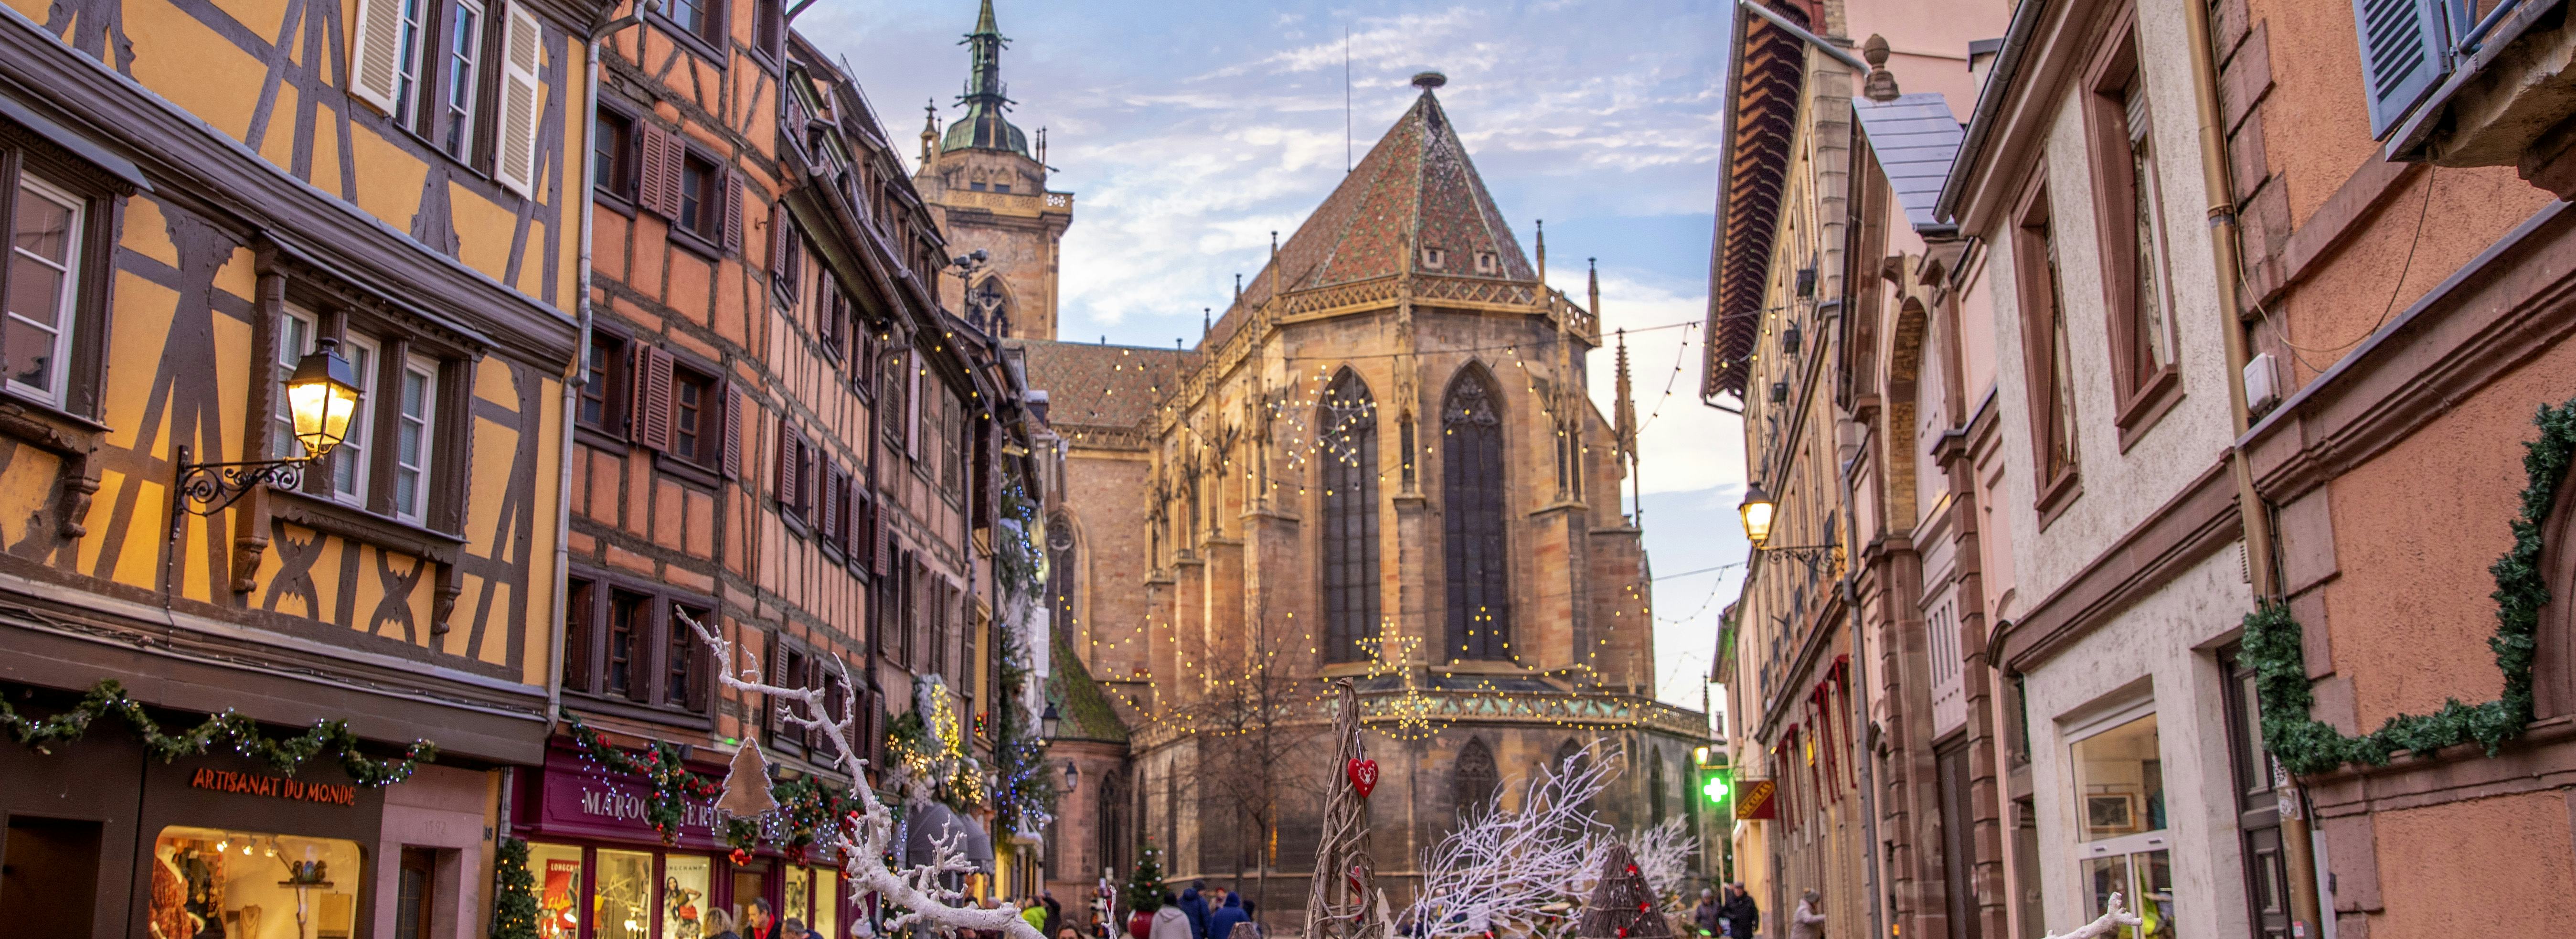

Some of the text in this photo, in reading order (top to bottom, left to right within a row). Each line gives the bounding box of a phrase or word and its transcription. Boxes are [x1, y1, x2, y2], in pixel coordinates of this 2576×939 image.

[192, 767, 356, 806] ARTISANAT DU MONDE
[484, 826, 493, 841] 18
